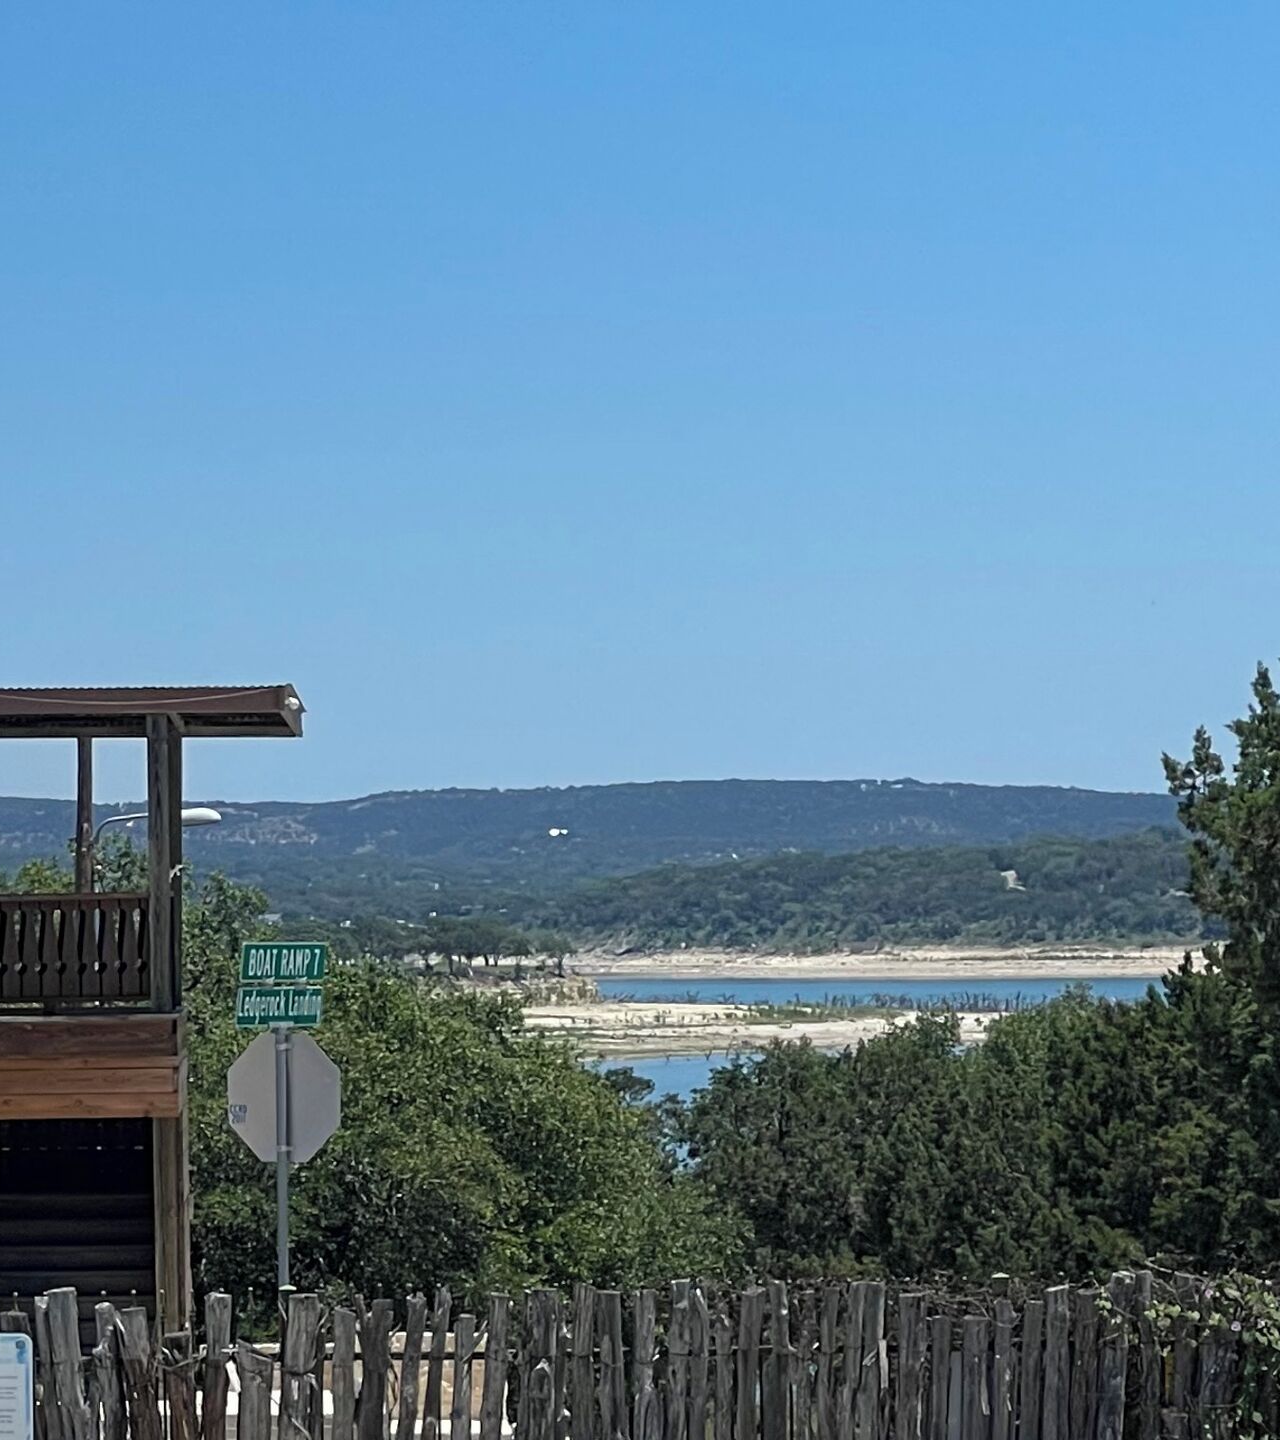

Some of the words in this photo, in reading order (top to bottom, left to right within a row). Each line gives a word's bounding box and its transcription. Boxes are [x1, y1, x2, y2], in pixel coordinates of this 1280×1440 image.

[248, 948, 278, 976] BOAT
[280, 948, 311, 976] RAMP
[313, 948, 321, 976] 7
[238, 990, 286, 1024] Ledgerock
[288, 990, 322, 1023] Landing
